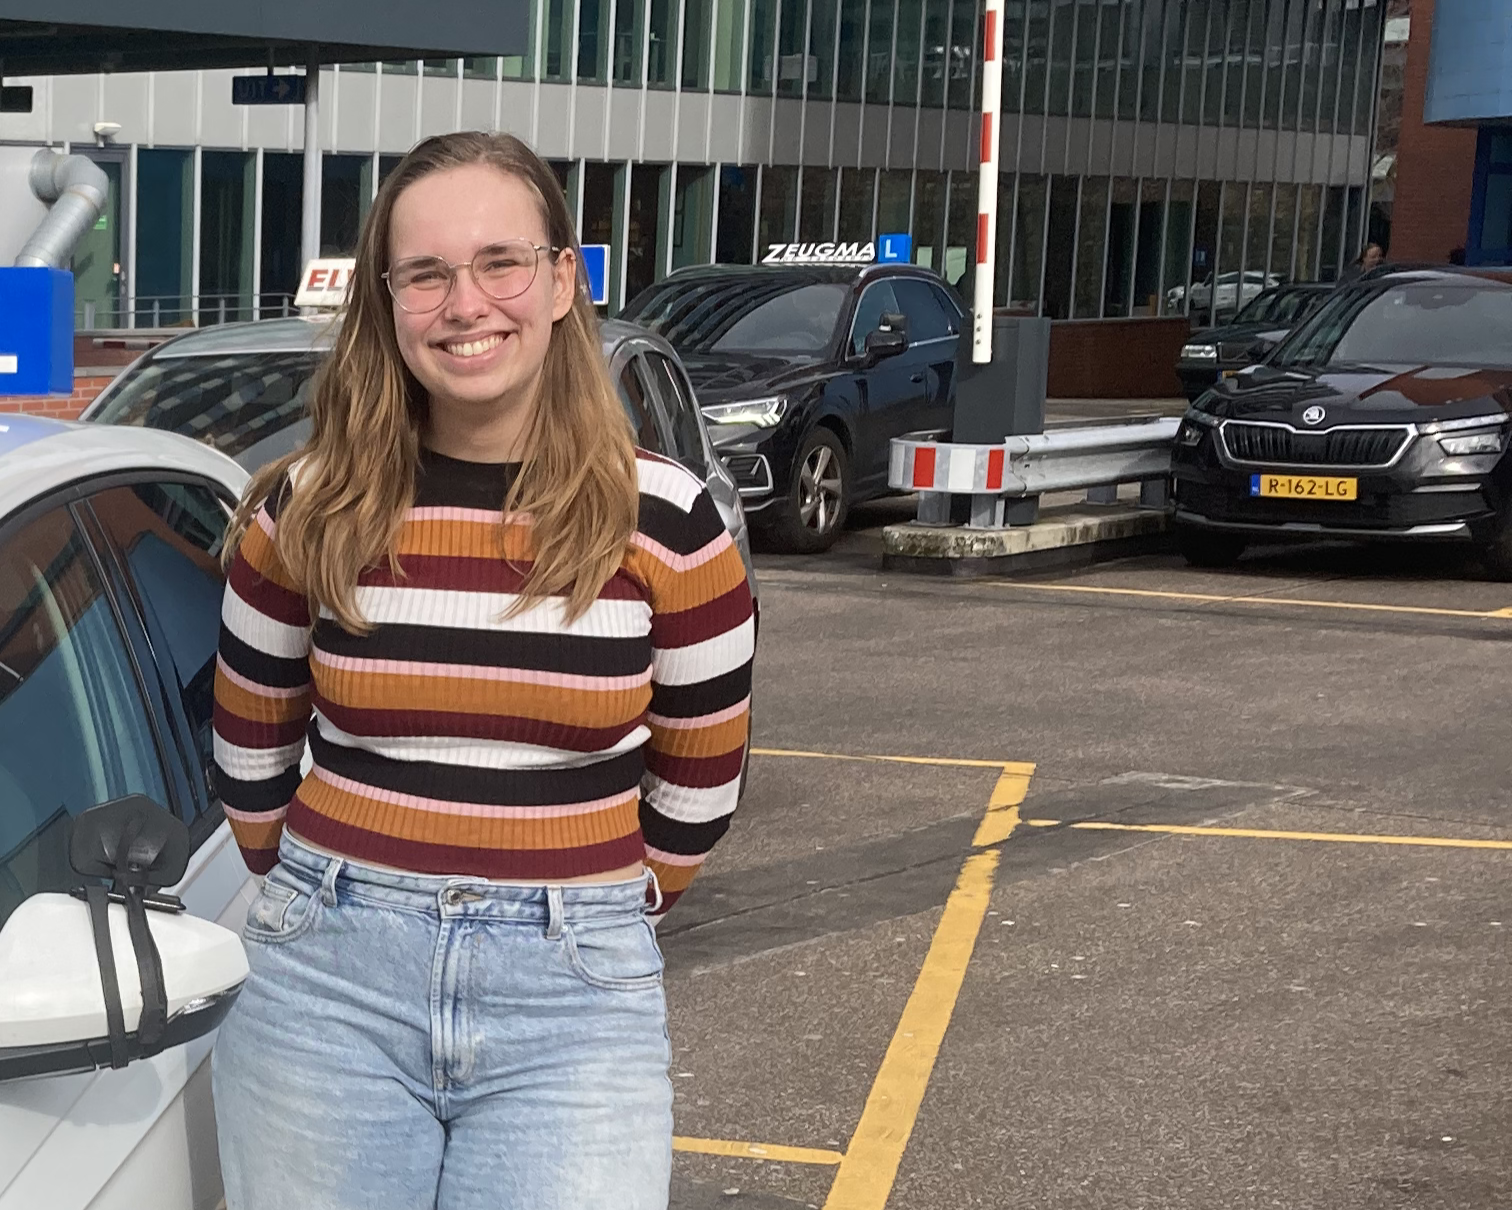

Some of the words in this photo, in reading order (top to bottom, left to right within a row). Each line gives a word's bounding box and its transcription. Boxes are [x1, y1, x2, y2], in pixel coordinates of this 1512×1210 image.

[762, 242, 875, 262] ZEUGMA
[885, 239, 897, 258] L
[1268, 478, 1348, 496] R-162-LG
